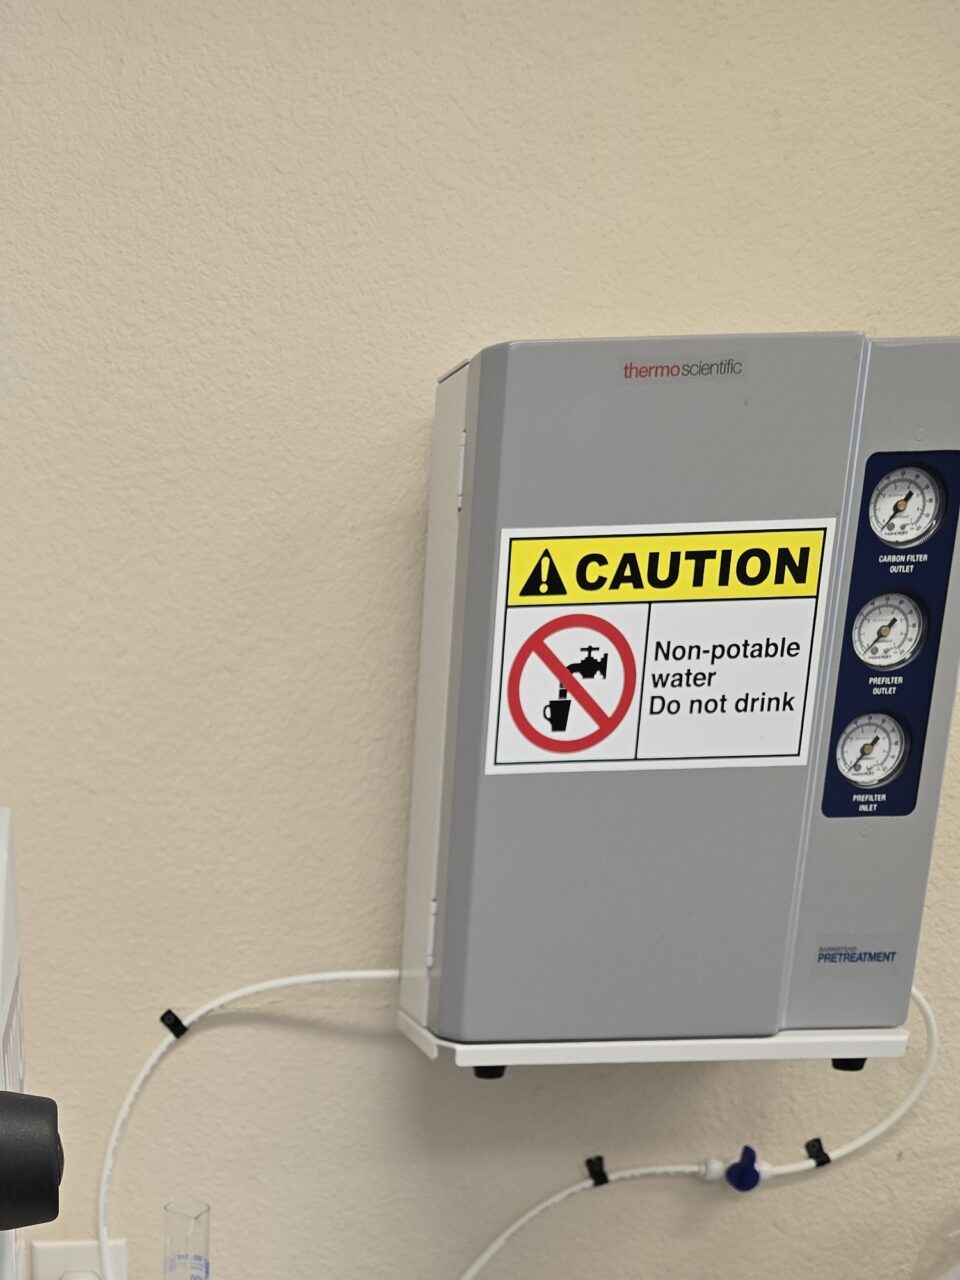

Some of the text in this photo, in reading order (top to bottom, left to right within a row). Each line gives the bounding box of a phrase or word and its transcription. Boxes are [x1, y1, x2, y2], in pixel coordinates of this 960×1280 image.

[878, 554, 928, 563] CARBON FILTER
[576, 547, 811, 591] CAUTION
[889, 565, 914, 573] OUTLET
[653, 637, 801, 665] Non-potable
[651, 668, 717, 688] water
[868, 676, 904, 685] PREFILTER
[872, 686, 897, 695] OUTLET
[649, 691, 796, 715] Do not drink
[852, 793, 887, 803] PREFILTER
[858, 803, 878, 812] INLET
[817, 951, 897, 963] PRETREATMENT
